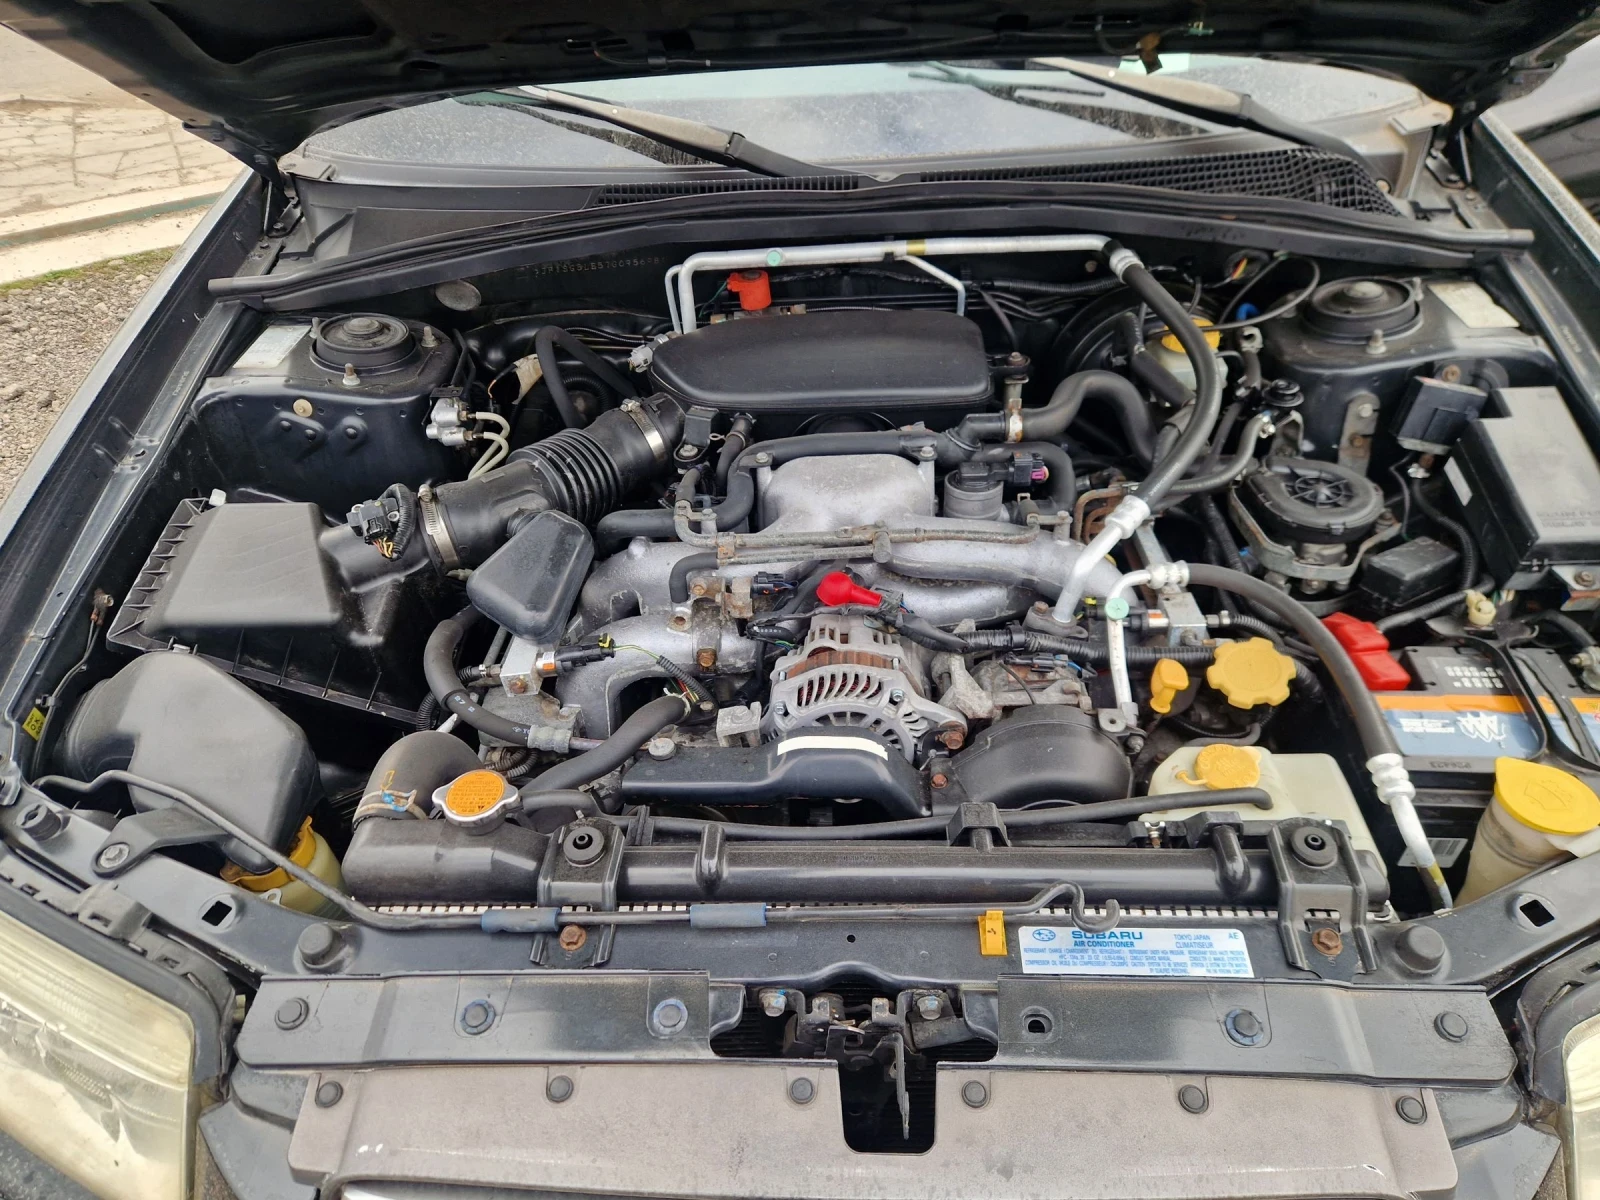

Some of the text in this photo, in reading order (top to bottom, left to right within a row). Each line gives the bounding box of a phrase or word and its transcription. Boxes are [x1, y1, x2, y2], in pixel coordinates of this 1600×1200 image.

[1071, 930, 1143, 940] SUBARU
[1087, 940, 1135, 948] CONDITIONER
[1175, 941, 1214, 949] CLIMATISEUR
